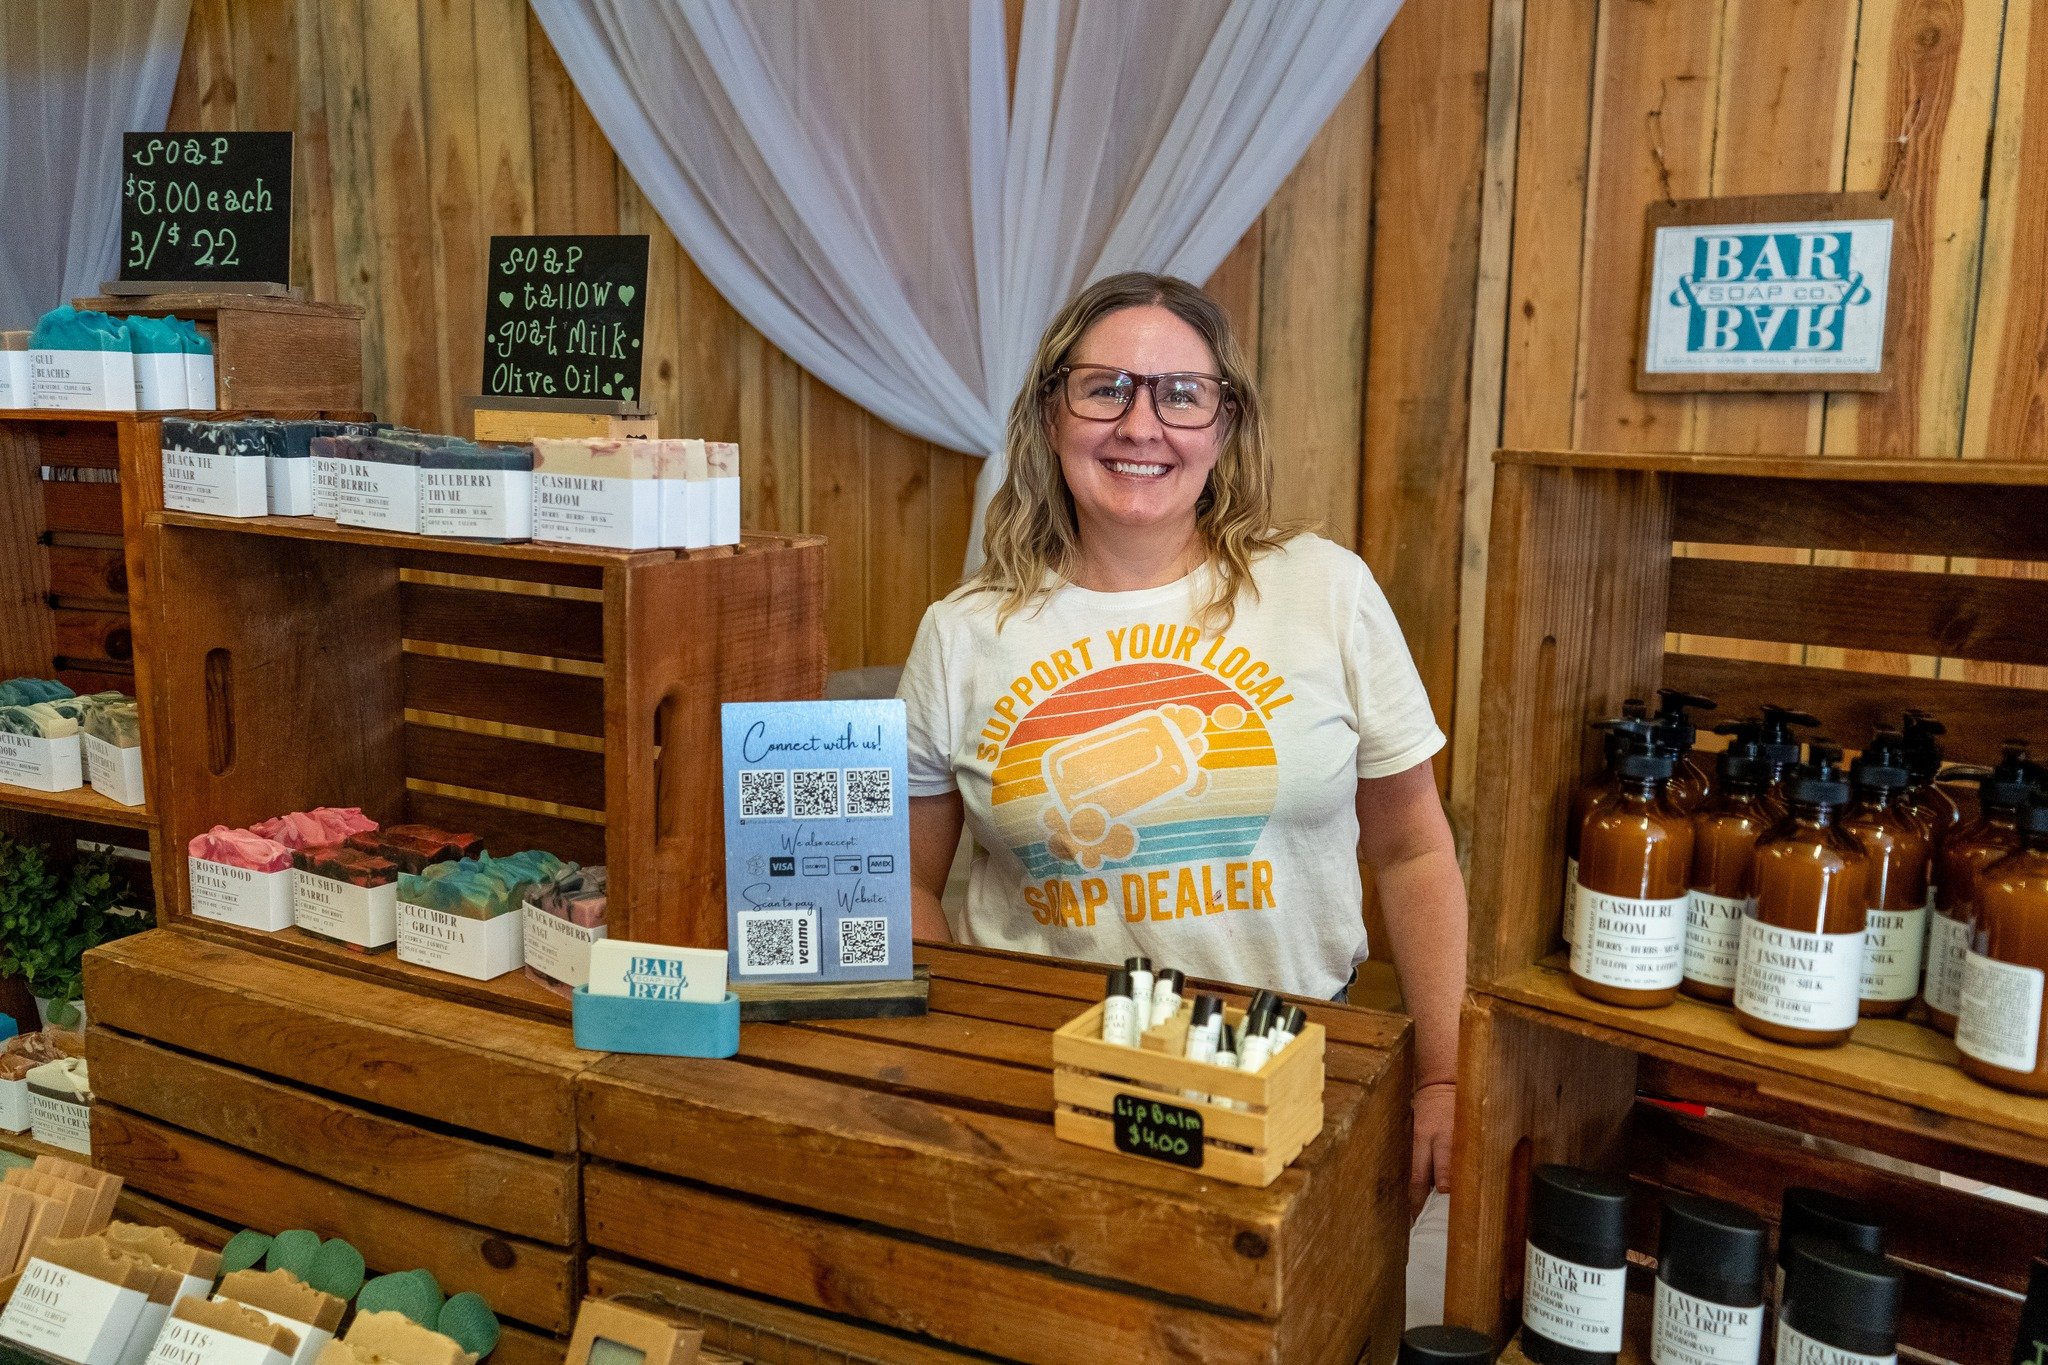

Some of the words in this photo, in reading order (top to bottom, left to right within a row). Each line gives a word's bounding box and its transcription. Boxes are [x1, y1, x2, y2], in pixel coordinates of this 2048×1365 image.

[207, 178, 273, 213] each
[1698, 233, 1844, 282] BAR
[1708, 286, 1783, 301] SOAP
[497, 316, 558, 358] goat
[36, 368, 70, 379] BEACHES
[492, 363, 557, 394] Olive
[565, 364, 599, 394] Oil
[167, 453, 195, 467] BLACK
[198, 456, 213, 469] TIE
[340, 463, 370, 477] DARK
[168, 467, 195, 480] AFFAIR
[427, 473, 492, 487] BLUEBERRY
[541, 475, 606, 492] CASHMERE
[340, 478, 379, 493] BERRIES
[428, 489, 461, 501] THYME
[542, 492, 580, 507] BLOOM
[975, 635, 1095, 763] SUPPORT
[1106, 623, 1202, 662] YOUR
[1200, 635, 1295, 721] LOCAL
[742, 720, 821, 763] Connect
[823, 722, 859, 751] with
[862, 724, 882, 751] us!
[805, 831, 823, 847] also
[196, 860, 252, 882] ROSEWOOD
[772, 863, 794, 871] VISA
[196, 874, 227, 889] PETALS
[299, 873, 343, 895] BLUSHED
[300, 887, 331, 905] BARREL
[1024, 876, 1110, 928] SOAP
[1121, 859, 1277, 924] DEALER
[405, 904, 457, 928] CUCUMBER
[1599, 899, 1672, 918] CASHMERE
[412, 920, 443, 938] GREEN
[447, 929, 465, 944] TEA
[548, 917, 592, 943] RASPBERRY
[1597, 916, 1647, 935] BLOOM
[798, 918, 809, 965] venmo
[1753, 926, 1834, 954] CUCUMBER
[634, 957, 681, 977] BAR
[1757, 948, 1814, 971] JASMINE
[1117, 1098, 1148, 1124] Lip
[1151, 1103, 1201, 1131] Balm
[1128, 1122, 1190, 1156] $4.00
[32, 1265, 67, 1287] OATS
[1534, 1252, 1578, 1281] BLACK
[1582, 1269, 1606, 1287] TIE
[1536, 1266, 1578, 1293] AFFAIR
[23, 1283, 61, 1307] HONEY
[1667, 1291, 1748, 1326] LAVENDER
[171, 1325, 209, 1348] OATS
[1581, 1323, 1610, 1334] CEDAR
